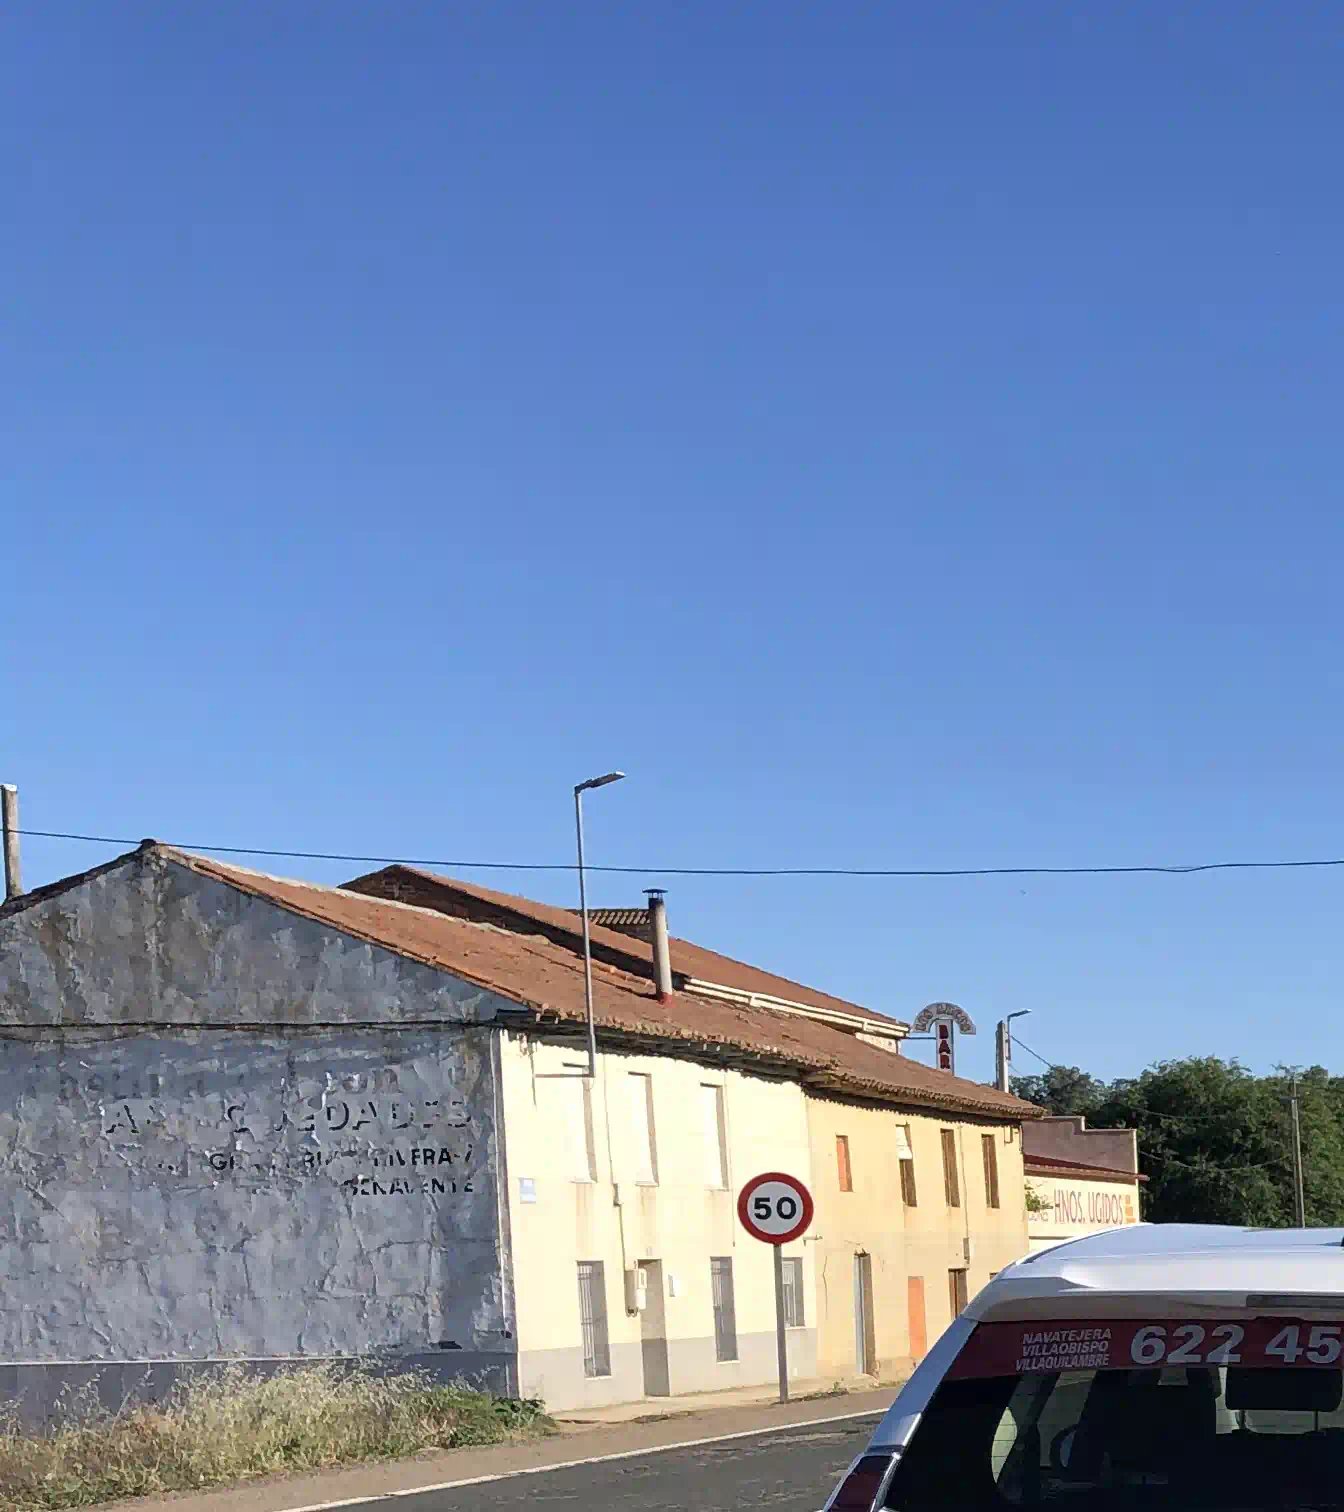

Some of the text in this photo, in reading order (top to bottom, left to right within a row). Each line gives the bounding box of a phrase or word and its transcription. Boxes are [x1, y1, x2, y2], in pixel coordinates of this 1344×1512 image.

[938, 1024, 951, 1070] BAR
[754, 1196, 797, 1221] 50
[1022, 1328, 1112, 1345] NAVATEJERA
[1130, 1324, 1245, 1366] 622
[1265, 1326, 1342, 1364] 45
[1022, 1341, 1109, 1357] VILLAOBISPO
[1015, 1354, 1110, 1371] VILLAQUILAMBRE
